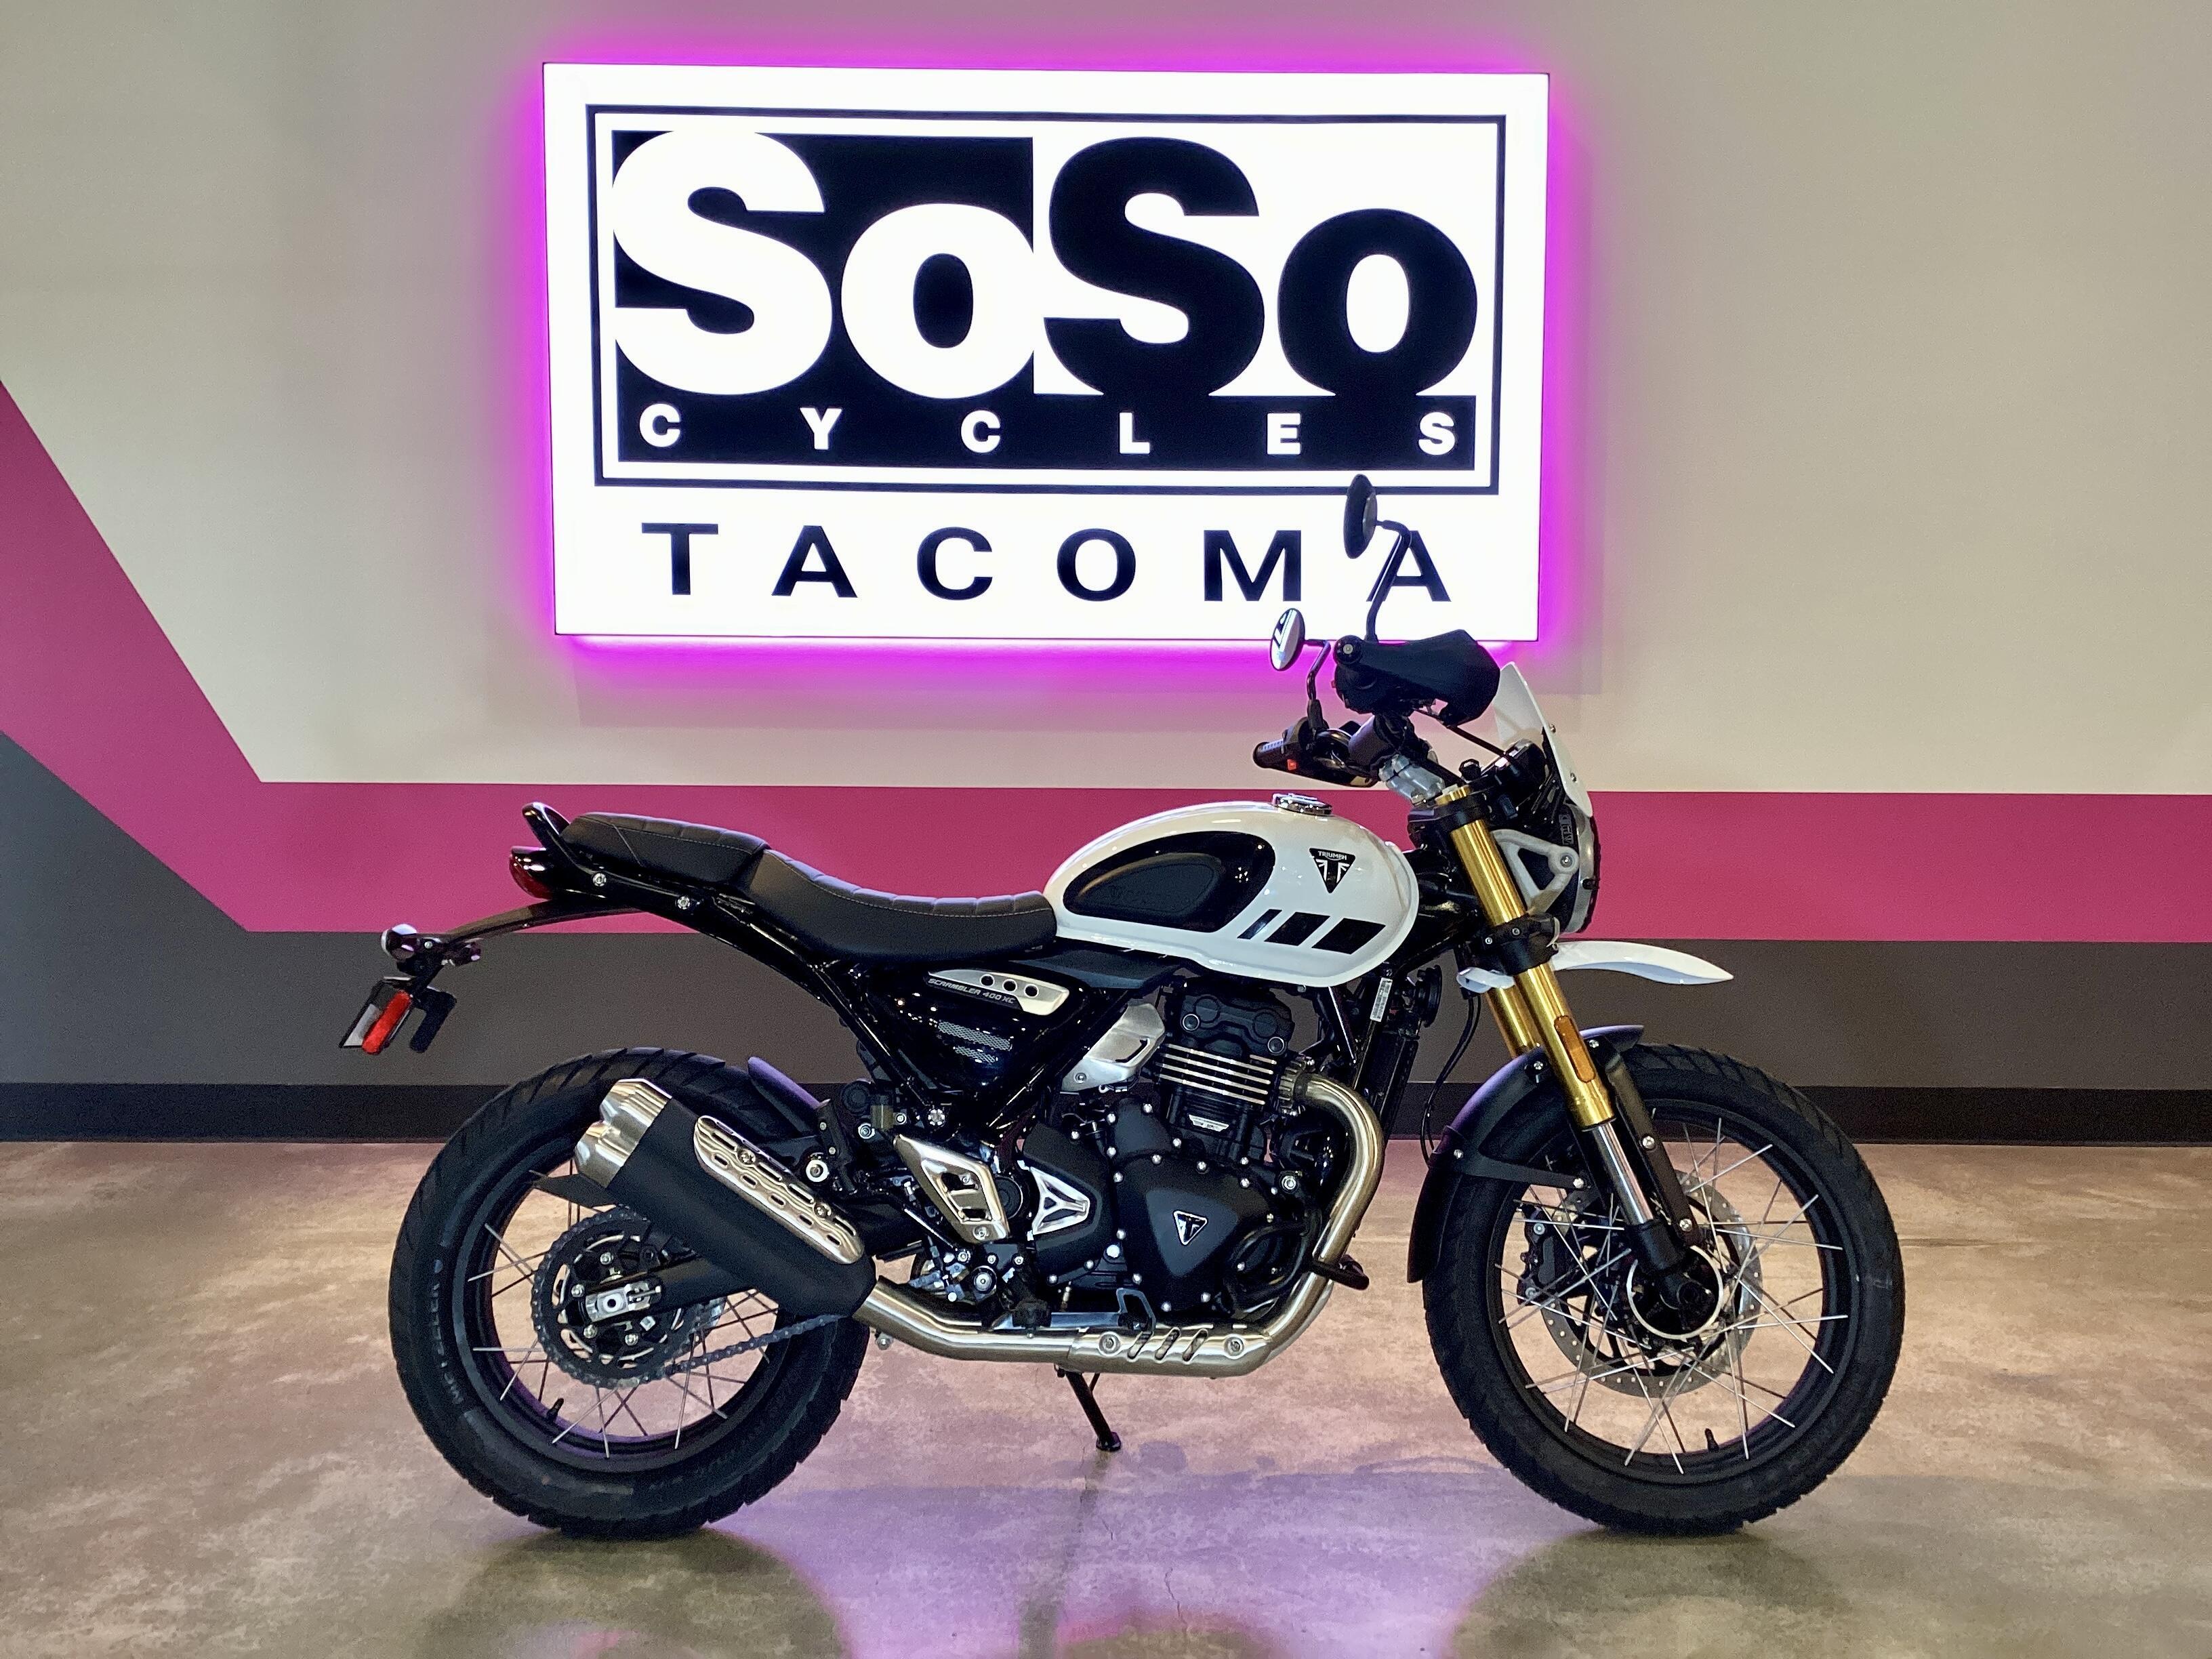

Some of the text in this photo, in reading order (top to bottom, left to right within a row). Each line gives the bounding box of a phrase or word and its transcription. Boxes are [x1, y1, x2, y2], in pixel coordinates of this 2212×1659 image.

[639, 403, 1456, 455] CYCLES
[641, 523, 1452, 602] TACOMA
[1317, 851, 1347, 861] TRIUMPH
[928, 978, 1017, 1004] SCRAMBLER 400 XC
